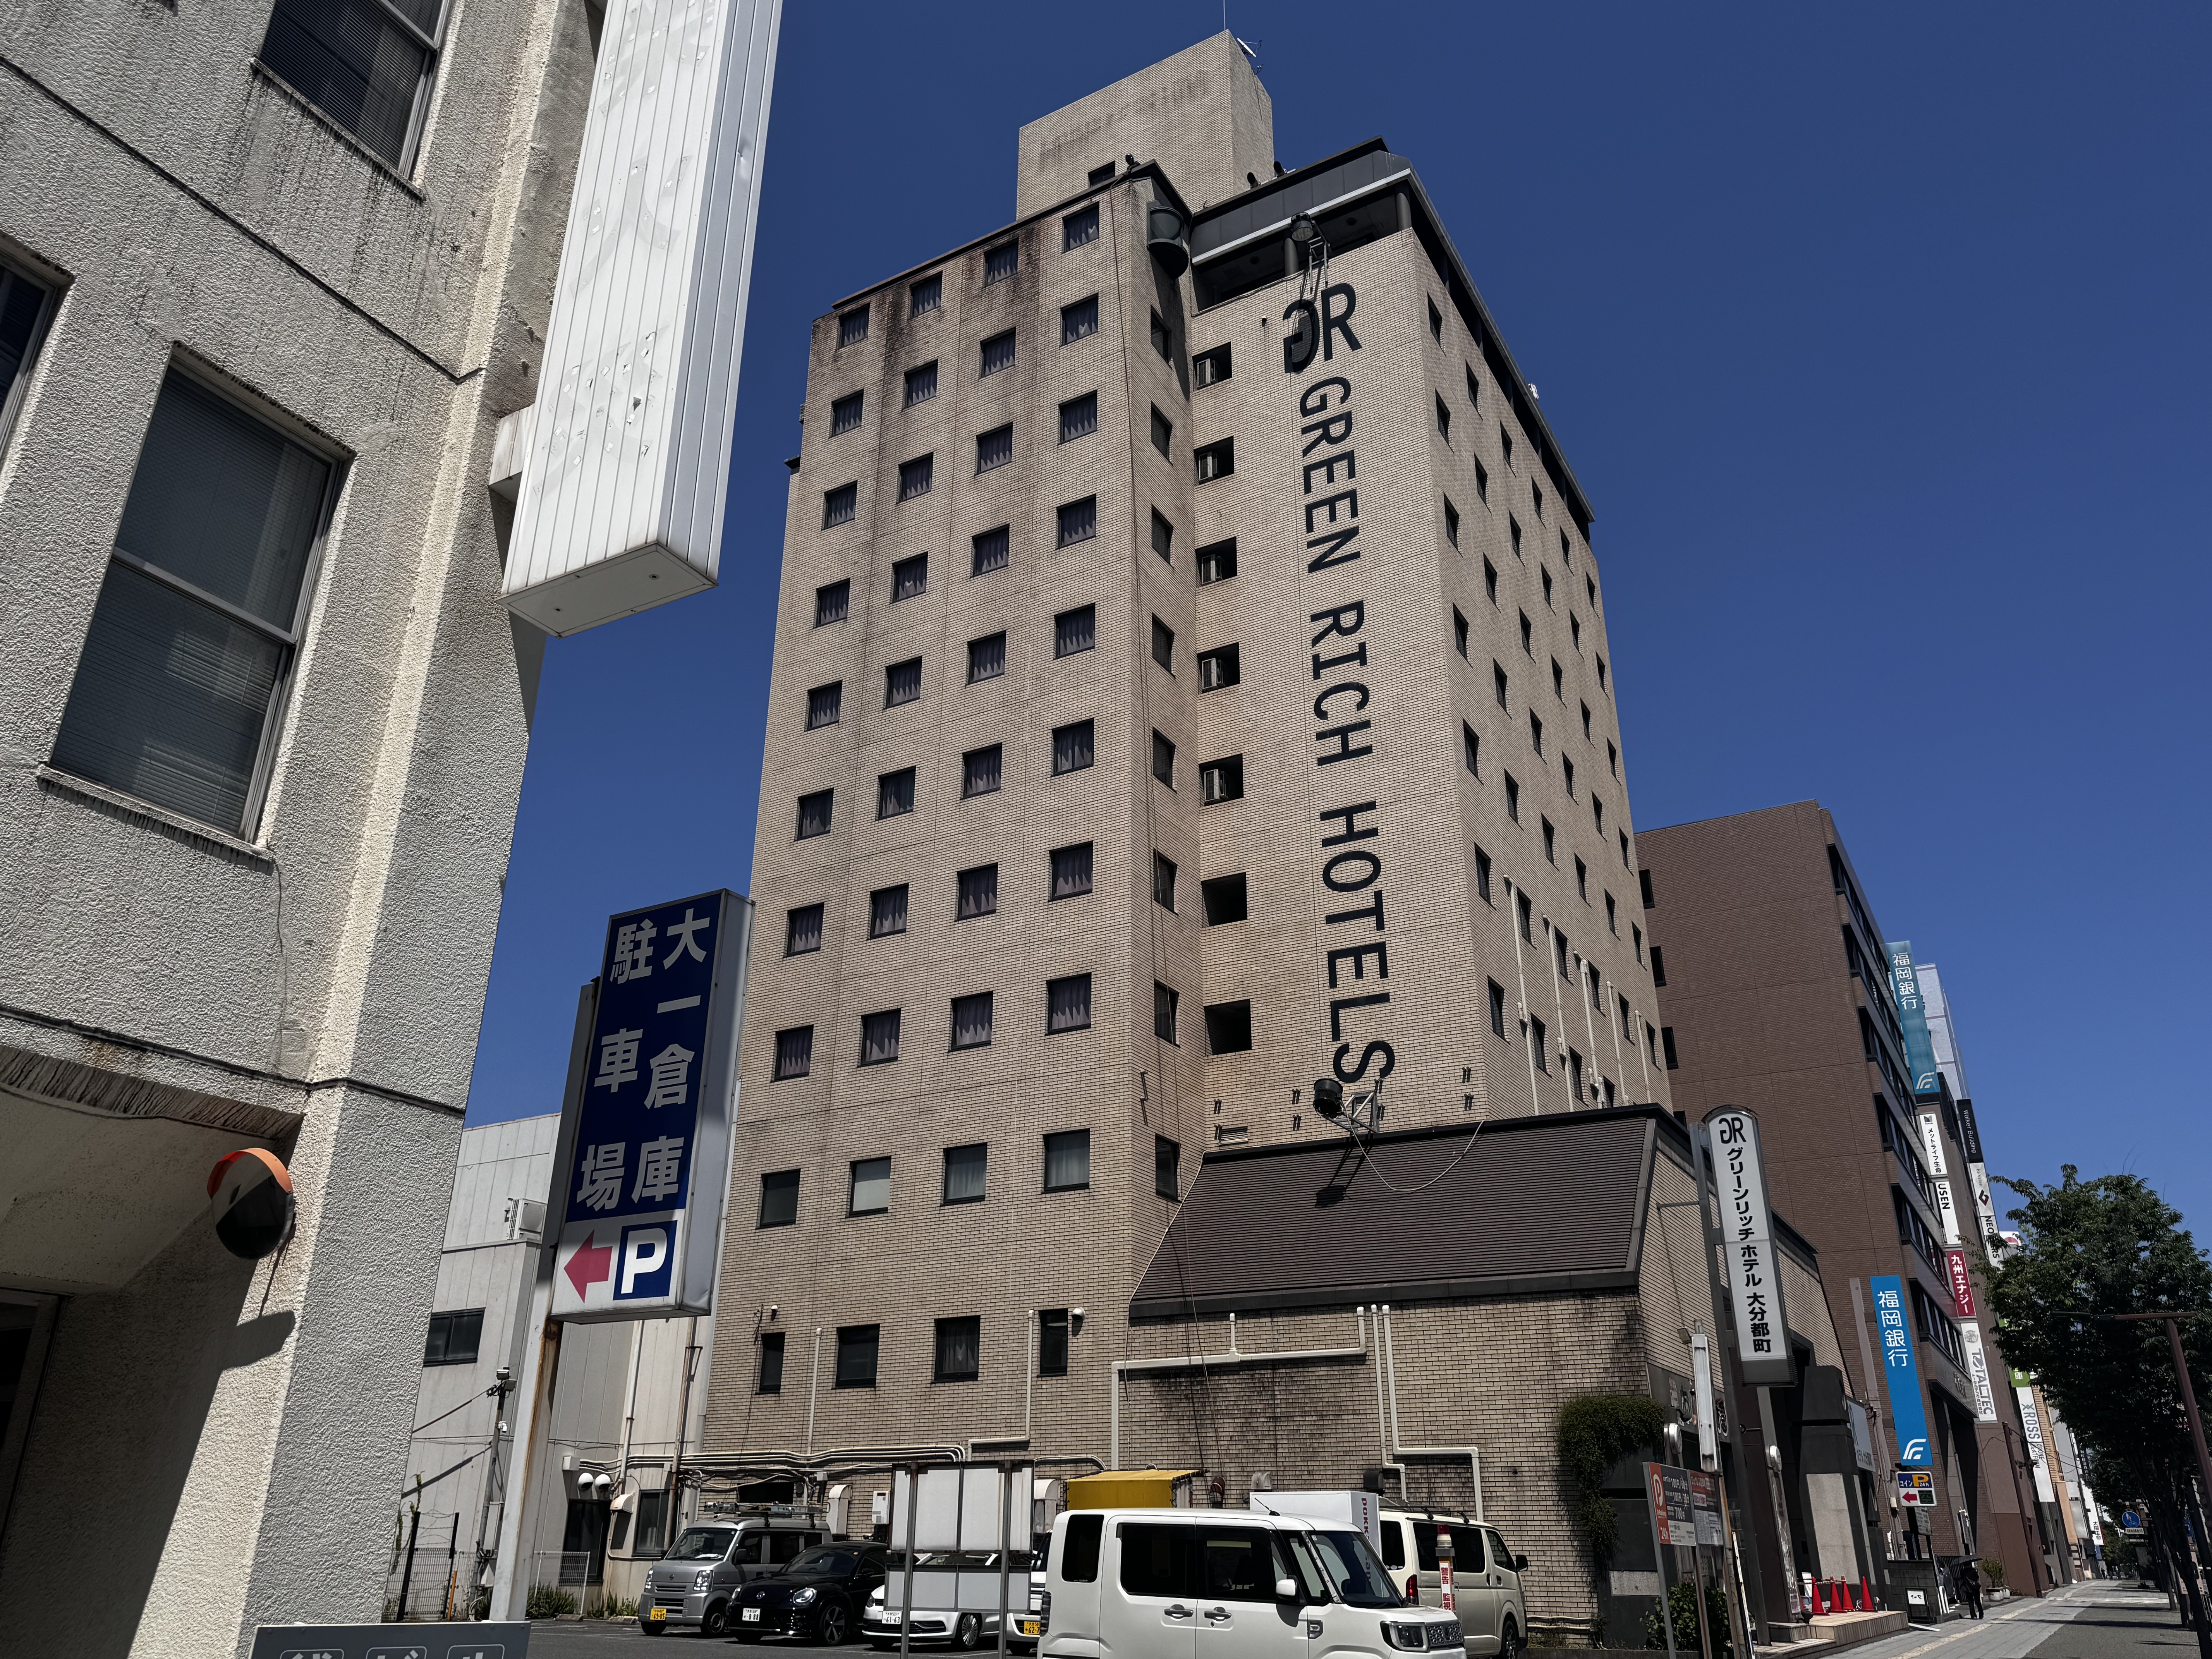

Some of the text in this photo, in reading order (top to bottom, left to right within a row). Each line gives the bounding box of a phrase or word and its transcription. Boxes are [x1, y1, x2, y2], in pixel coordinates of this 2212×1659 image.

[1299, 376, 1395, 1084] GREEN RICH HOTELS
[1892, 952, 1918, 1010] 福岡銀行
[577, 918, 658, 1212] 駐車場
[632, 908, 711, 1204] 大一倉庫
[1927, 1128, 1942, 1173] メットライフ生命
[1963, 1109, 1976, 1154] Walker Building
[1938, 1183, 1951, 1210] USEN
[620, 1228, 667, 1294] P
[1727, 1147, 1772, 1353] グリーンリッチ ホテル 大分都町
[1951, 1254, 1968, 1313] 九州エナジー
[1877, 1290, 1908, 1367] 福岡銀行
[1972, 1348, 1994, 1415] TOTALTEC
[1441, 1567, 1451, 1611] 警告 監視
